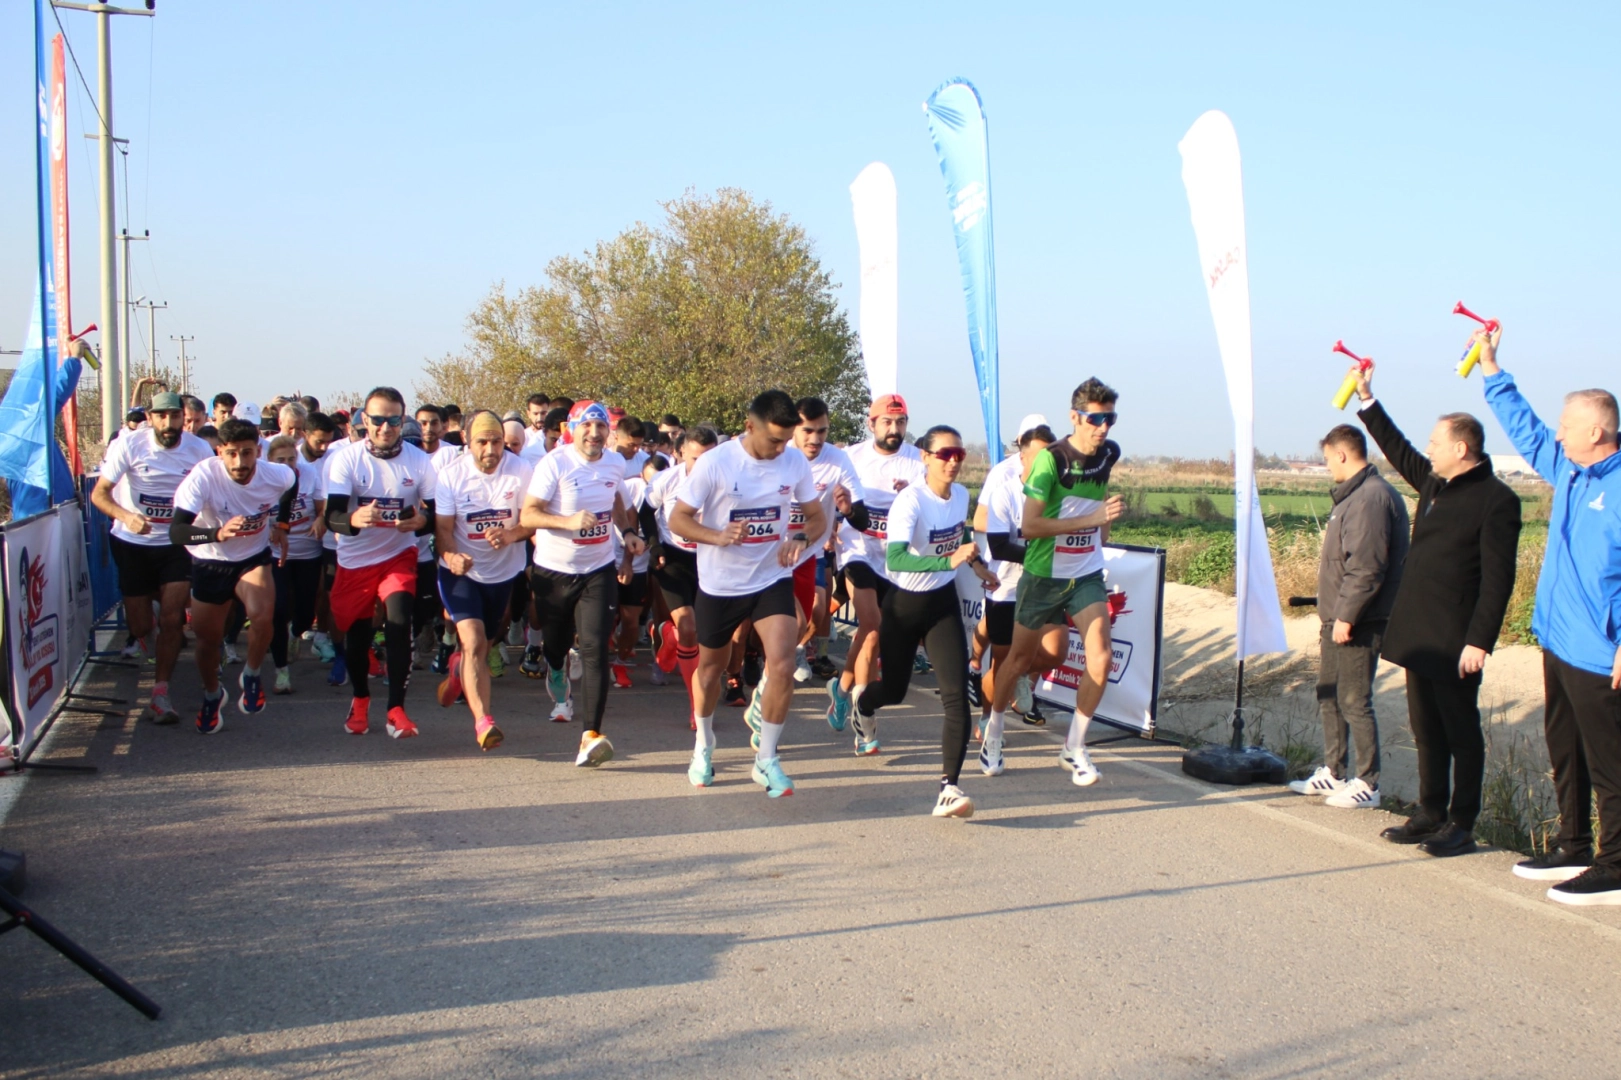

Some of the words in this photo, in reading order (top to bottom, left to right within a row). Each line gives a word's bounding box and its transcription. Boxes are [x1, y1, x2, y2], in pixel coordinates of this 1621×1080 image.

[145, 507, 173, 518] 0172
[290, 511, 303, 521] 93
[381, 510, 397, 521] 46
[789, 513, 805, 523] 21
[579, 524, 607, 538] 0333
[747, 523, 774, 536] 064
[1066, 535, 1092, 546] 0151
[935, 538, 960, 555] 0186
[962, 598, 983, 620] TUG
